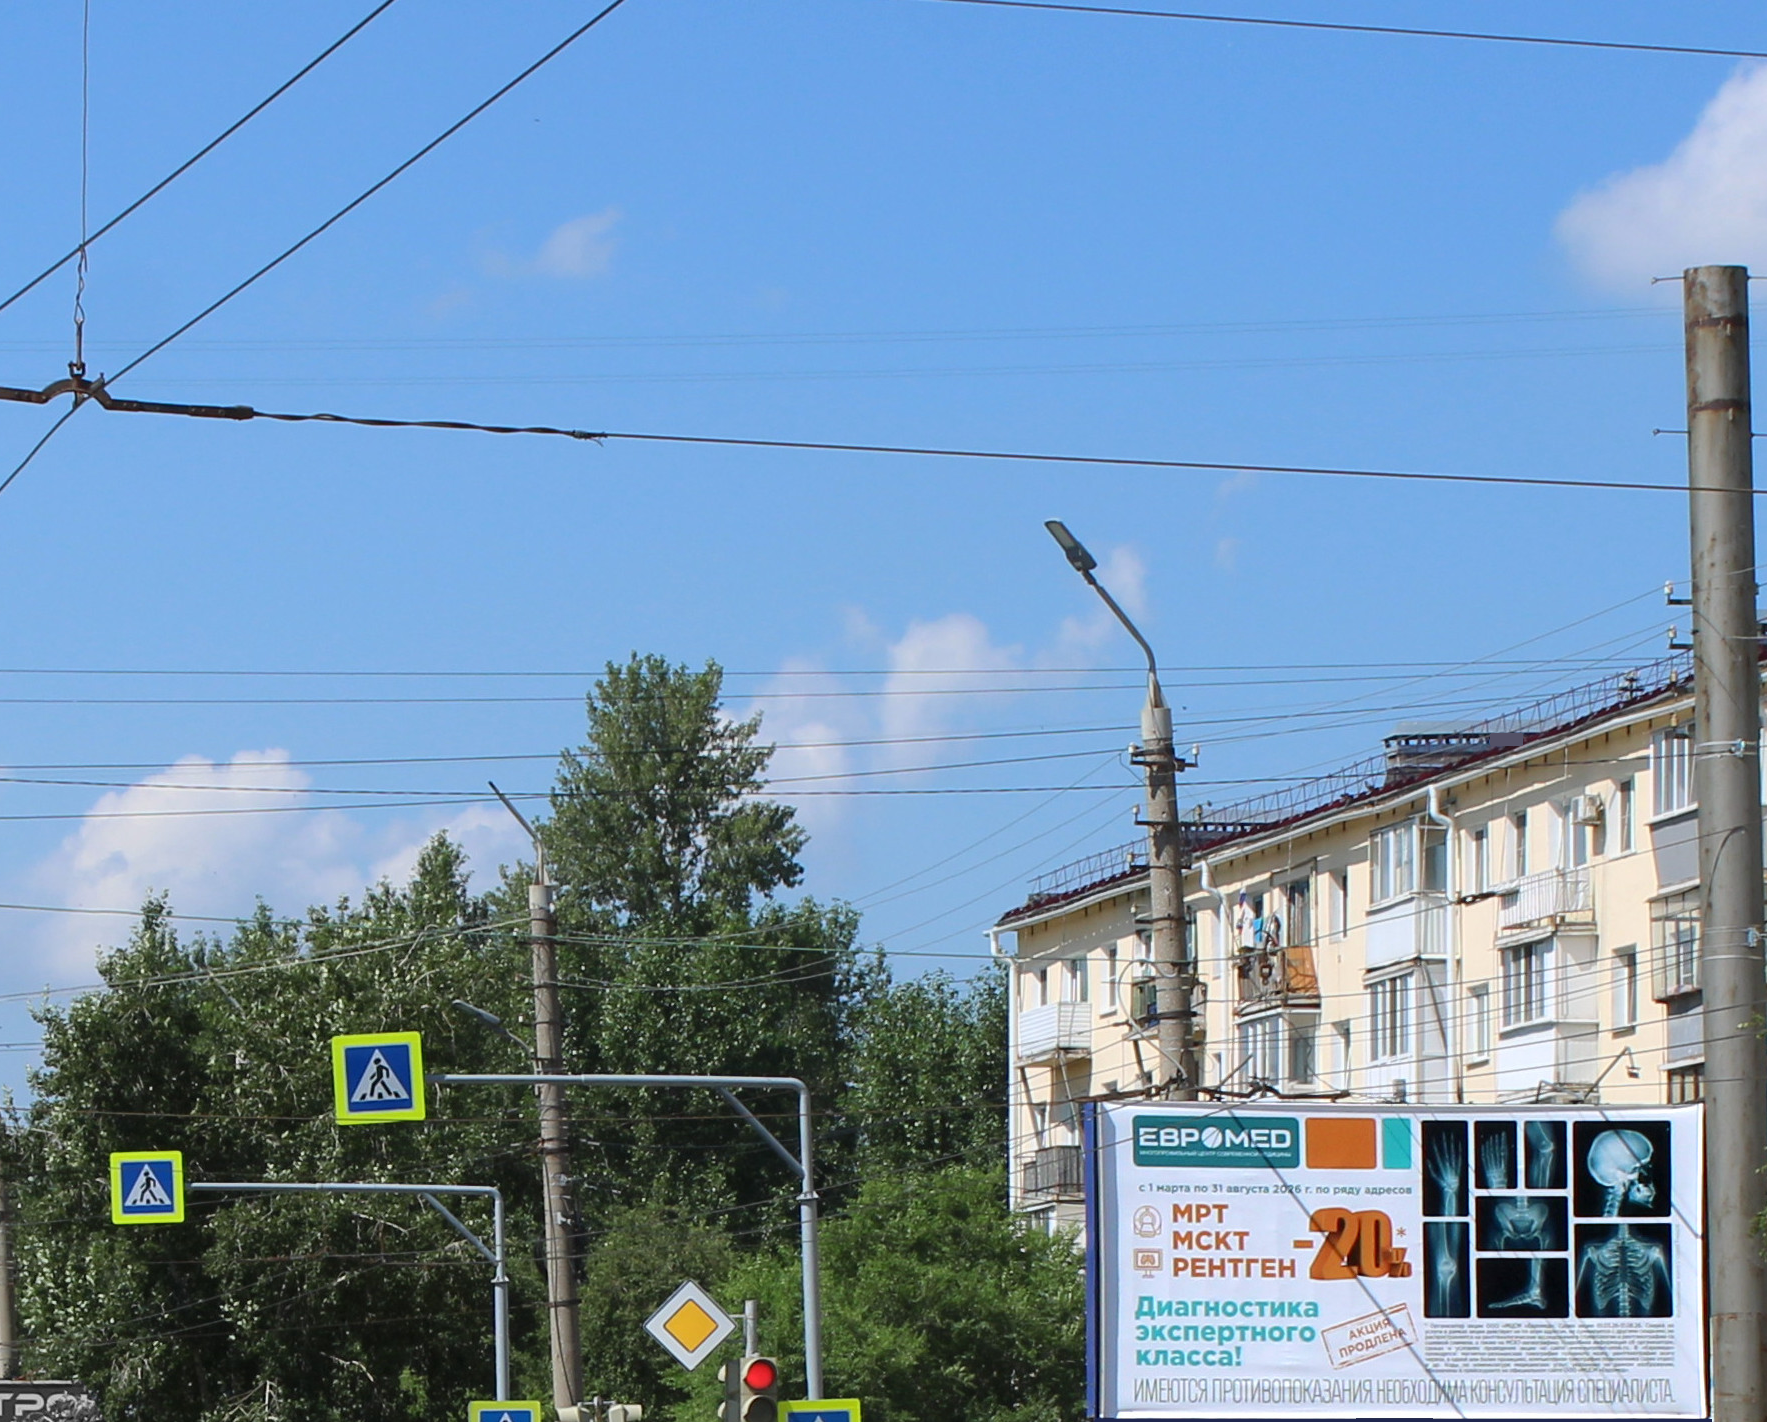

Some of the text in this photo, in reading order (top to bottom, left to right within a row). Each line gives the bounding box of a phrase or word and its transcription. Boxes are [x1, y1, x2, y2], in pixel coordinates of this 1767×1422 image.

[1157, 1186, 1191, 1195] марта
[1194, 1186, 1208, 1194] по
[1211, 1184, 1223, 1194] 31
[1226, 1186, 1270, 1196] августа
[1315, 1187, 1330, 1195] по
[1333, 1187, 1361, 1198] ряду
[1364, 1186, 1412, 1197] адресов
[1172, 1203, 1229, 1223] МРТ
[1172, 1230, 1250, 1251] МСКТ
[1173, 1258, 1296, 1279] РЕНТГЕН
[1134, 1296, 1319, 1320] Диагностика
[1135, 1324, 1316, 1346] экспертного
[1348, 1318, 1392, 1341] АКЦИЯ
[1338, 1327, 1408, 1359] ПРОДЛЕНА
[1136, 1346, 1242, 1366] класса!
[1134, 1378, 1208, 1404] ИМЕЮТСЯ
[1378, 1379, 1468, 1405] НЕОБХОДИМА
[1471, 1379, 1574, 1405] КОНСУЛЬТАЦИЯ
